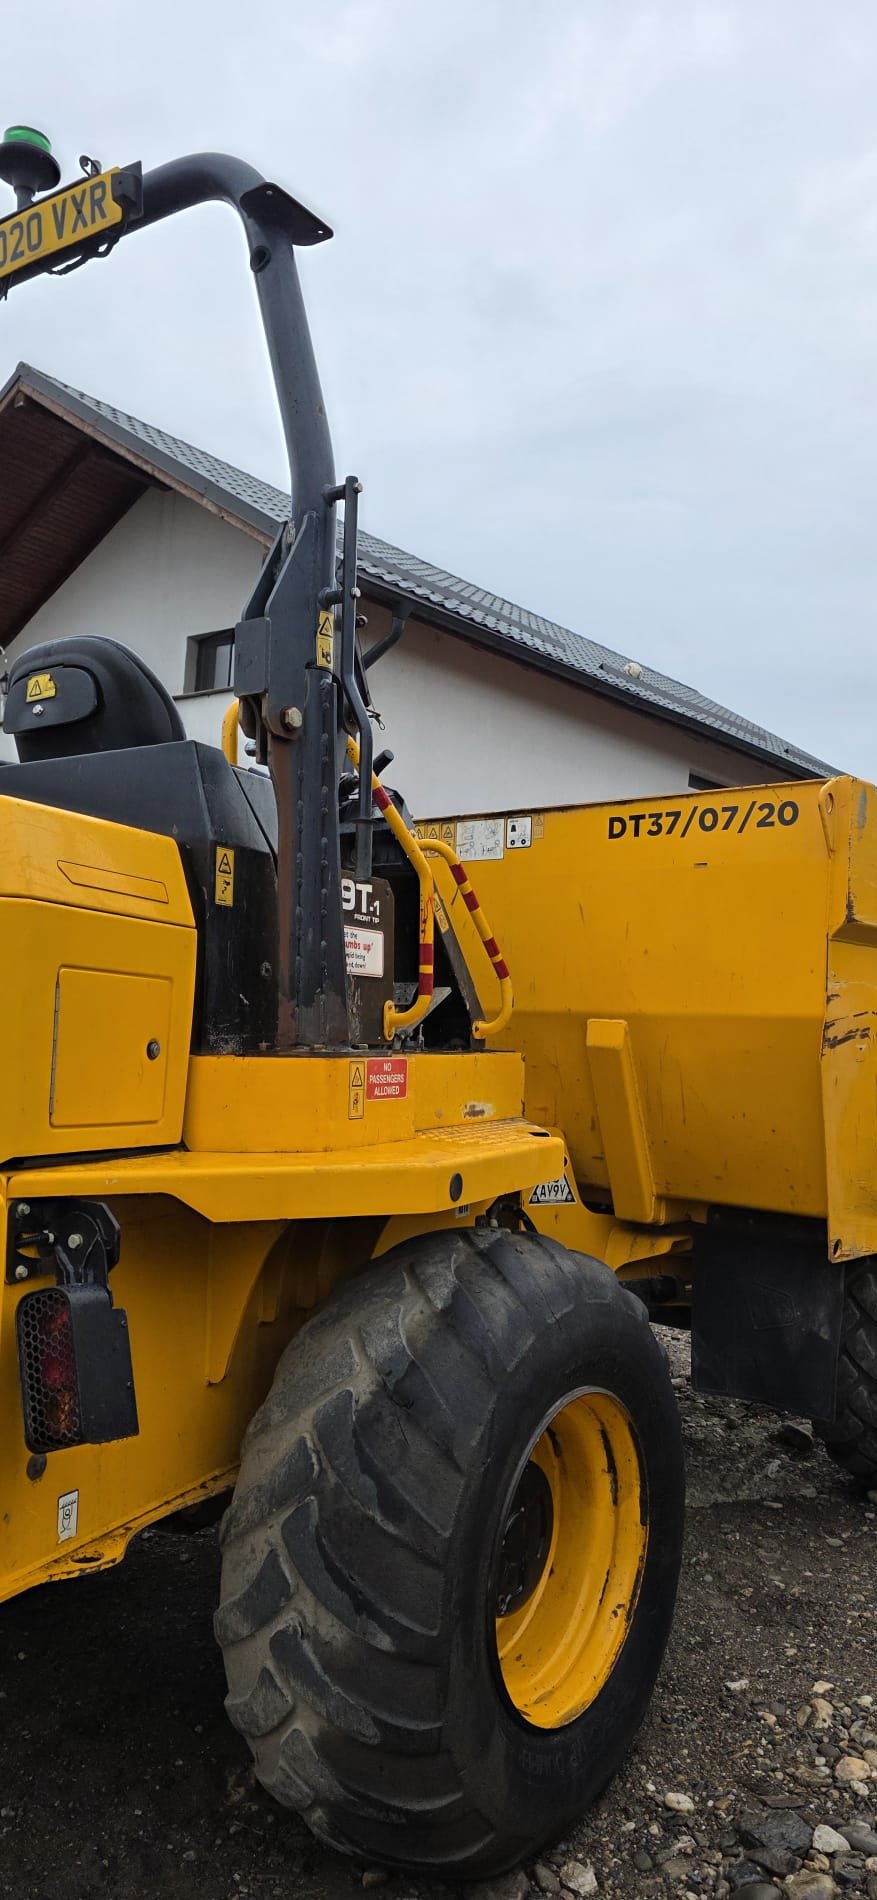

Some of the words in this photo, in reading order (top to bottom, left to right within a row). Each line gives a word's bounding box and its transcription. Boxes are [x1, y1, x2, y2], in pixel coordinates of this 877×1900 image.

[51, 181, 107, 241] VXR
[608, 800, 800, 840] DT37/07/20
[354, 913, 371, 923] FRONT
[383, 1062, 392, 1072] NO
[369, 1073, 405, 1085] PASSENGERS
[374, 1085, 400, 1096] ALLOWED
